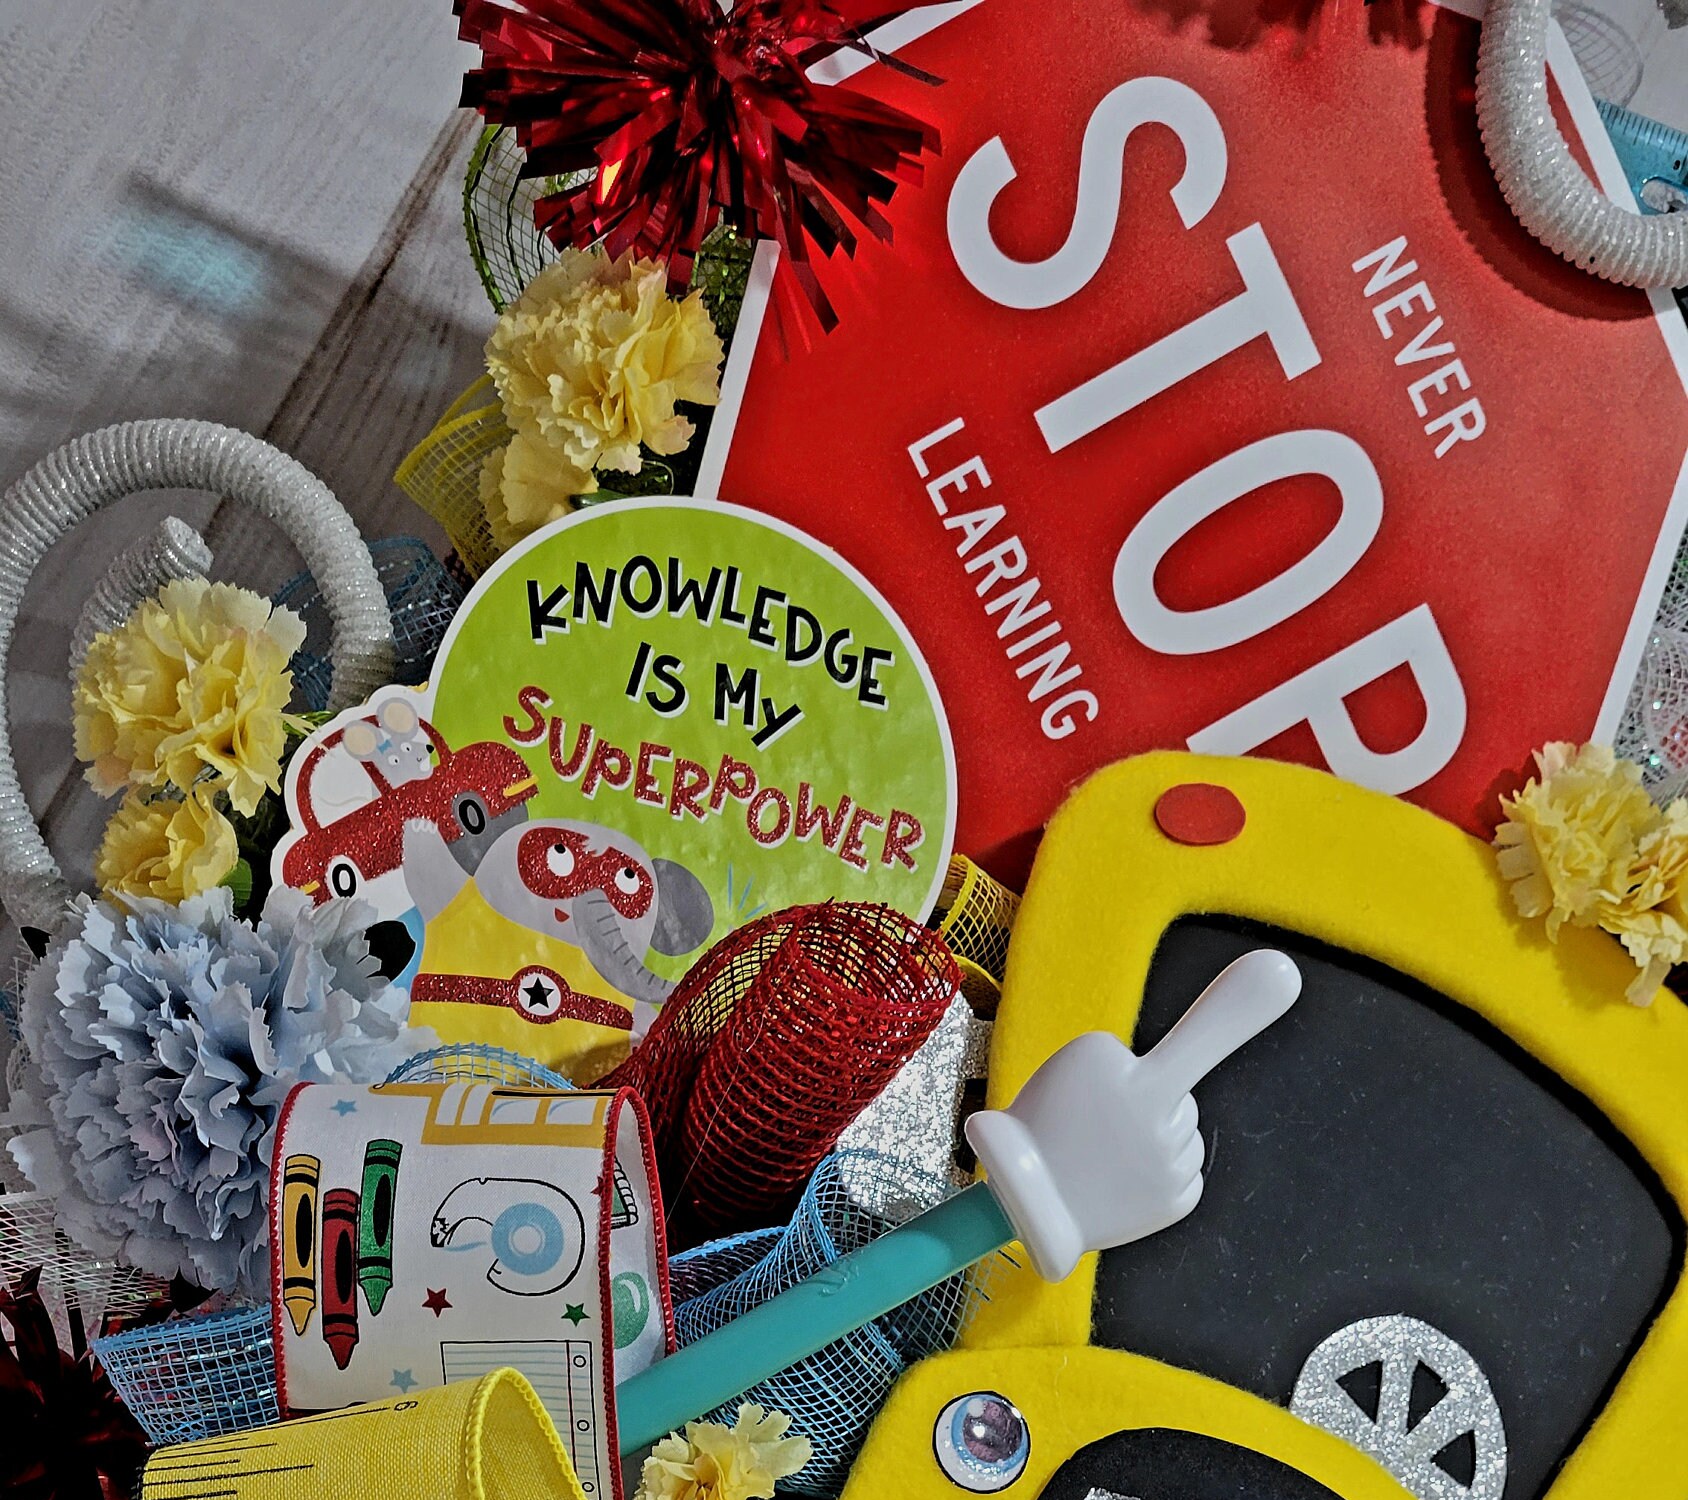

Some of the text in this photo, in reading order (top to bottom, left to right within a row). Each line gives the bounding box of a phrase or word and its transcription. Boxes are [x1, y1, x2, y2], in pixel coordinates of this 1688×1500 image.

[947, 76, 1468, 797] STOP
[1352, 234, 1487, 460] NEVER
[526, 554, 893, 706] KNOWLEDGE
[906, 417, 1099, 741] LEARNING
[503, 685, 923, 872] SUPERPOWER
[625, 642, 803, 747] IS MY
